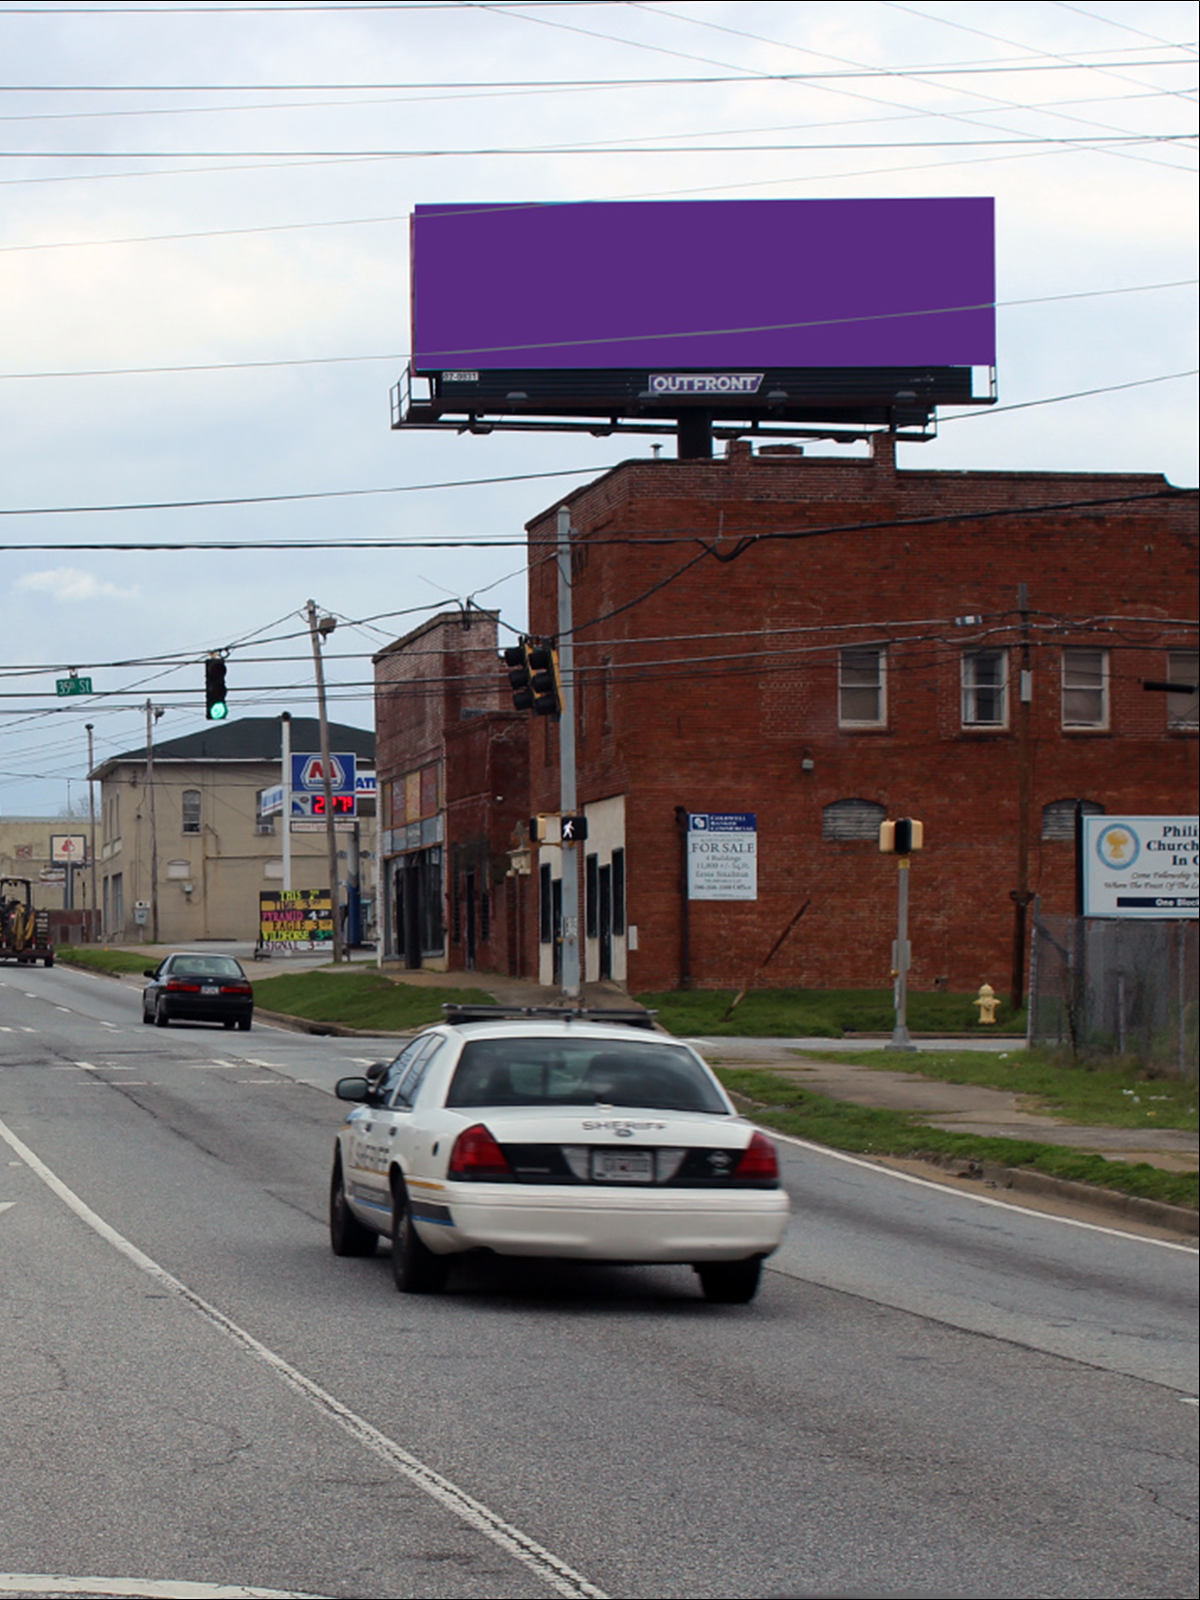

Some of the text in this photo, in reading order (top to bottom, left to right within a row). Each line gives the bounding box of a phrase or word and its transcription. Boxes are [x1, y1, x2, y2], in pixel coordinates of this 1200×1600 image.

[653, 377, 757, 390] OUTFRONT
[79, 679, 91, 693] St
[691, 843, 755, 853] FOR SALE
[1146, 839, 1199, 852] Church
[1171, 854, 1188, 866] In
[1155, 898, 1175, 907] One
[272, 920, 307, 931] EAGLE
[582, 1121, 667, 1131] SHERIFF
